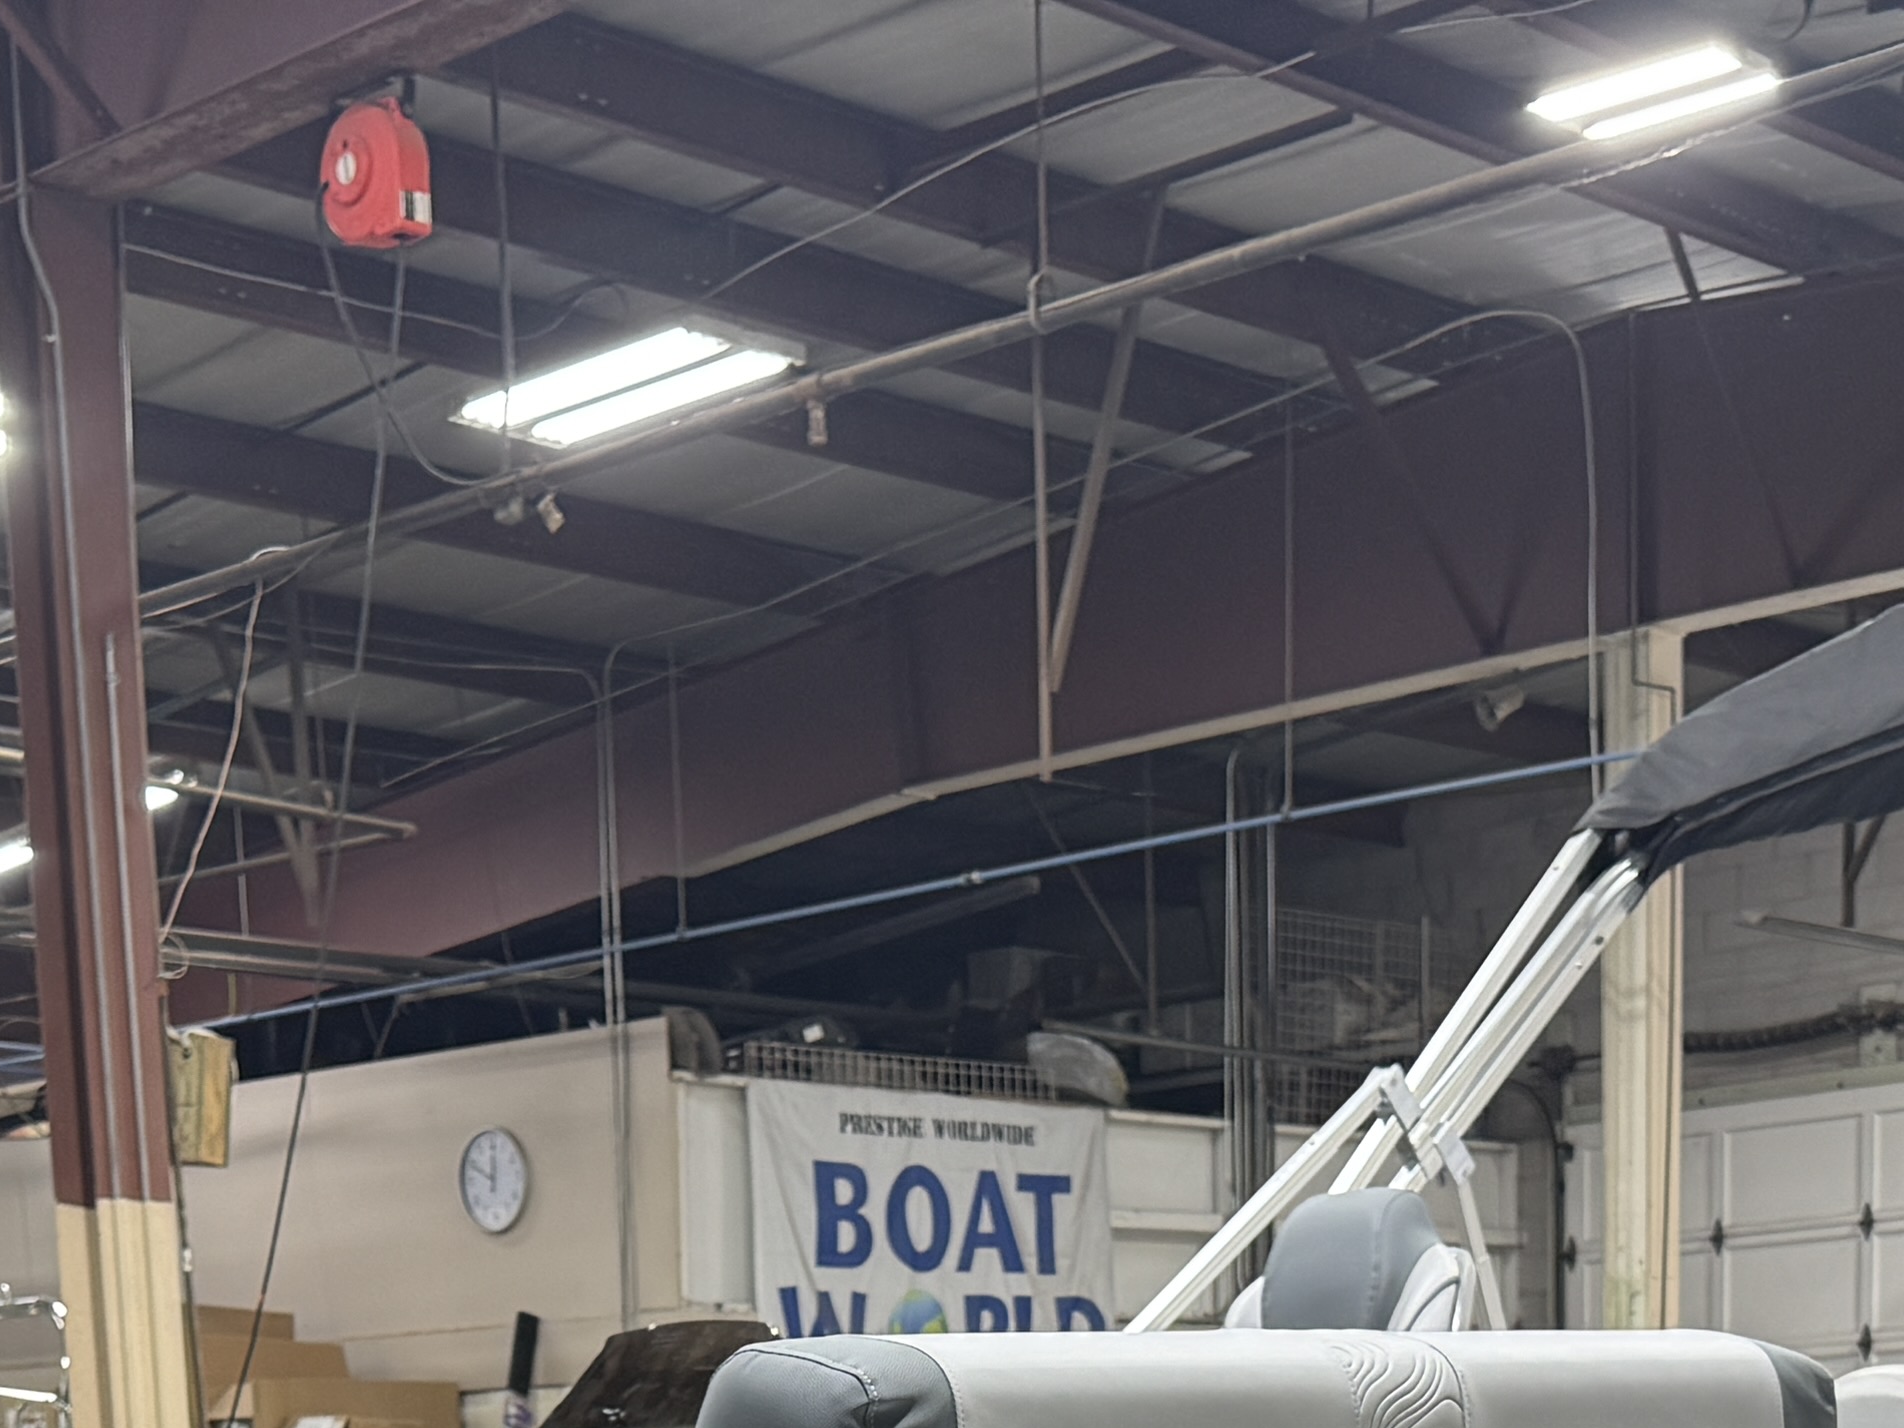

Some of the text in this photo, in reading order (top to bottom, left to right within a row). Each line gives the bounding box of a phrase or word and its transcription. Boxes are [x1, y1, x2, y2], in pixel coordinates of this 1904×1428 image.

[839, 1112, 1035, 1147] PRESTIGE WORLDWIDE
[813, 1160, 1071, 1275] BOAT
